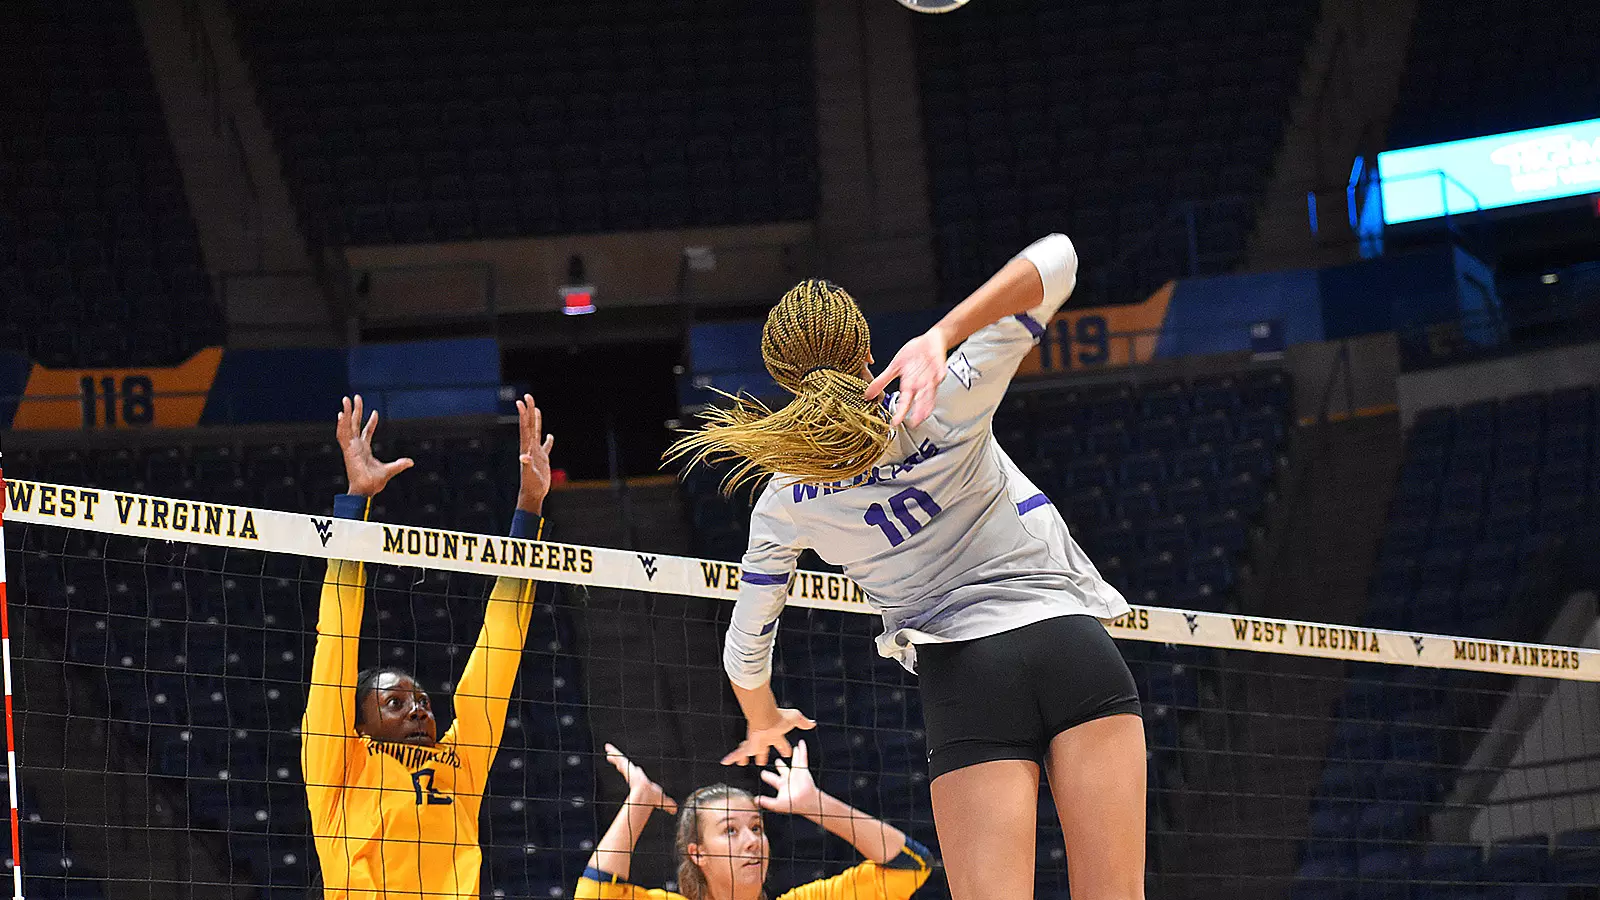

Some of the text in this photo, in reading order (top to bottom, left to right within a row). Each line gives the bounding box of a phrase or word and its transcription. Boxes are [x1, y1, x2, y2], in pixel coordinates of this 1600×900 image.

[1039, 315, 1109, 368] 119
[80, 375, 154, 427] 118
[6, 480, 259, 540] WEST VIRGINIA
[863, 486, 943, 548] 10
[382, 525, 594, 574] MOUNTAINEERS
[700, 561, 864, 604] WE IRGIN
[1231, 617, 1381, 653] WEST VIRGINIA
[1453, 639, 1580, 670] MOUNTAINEERS
